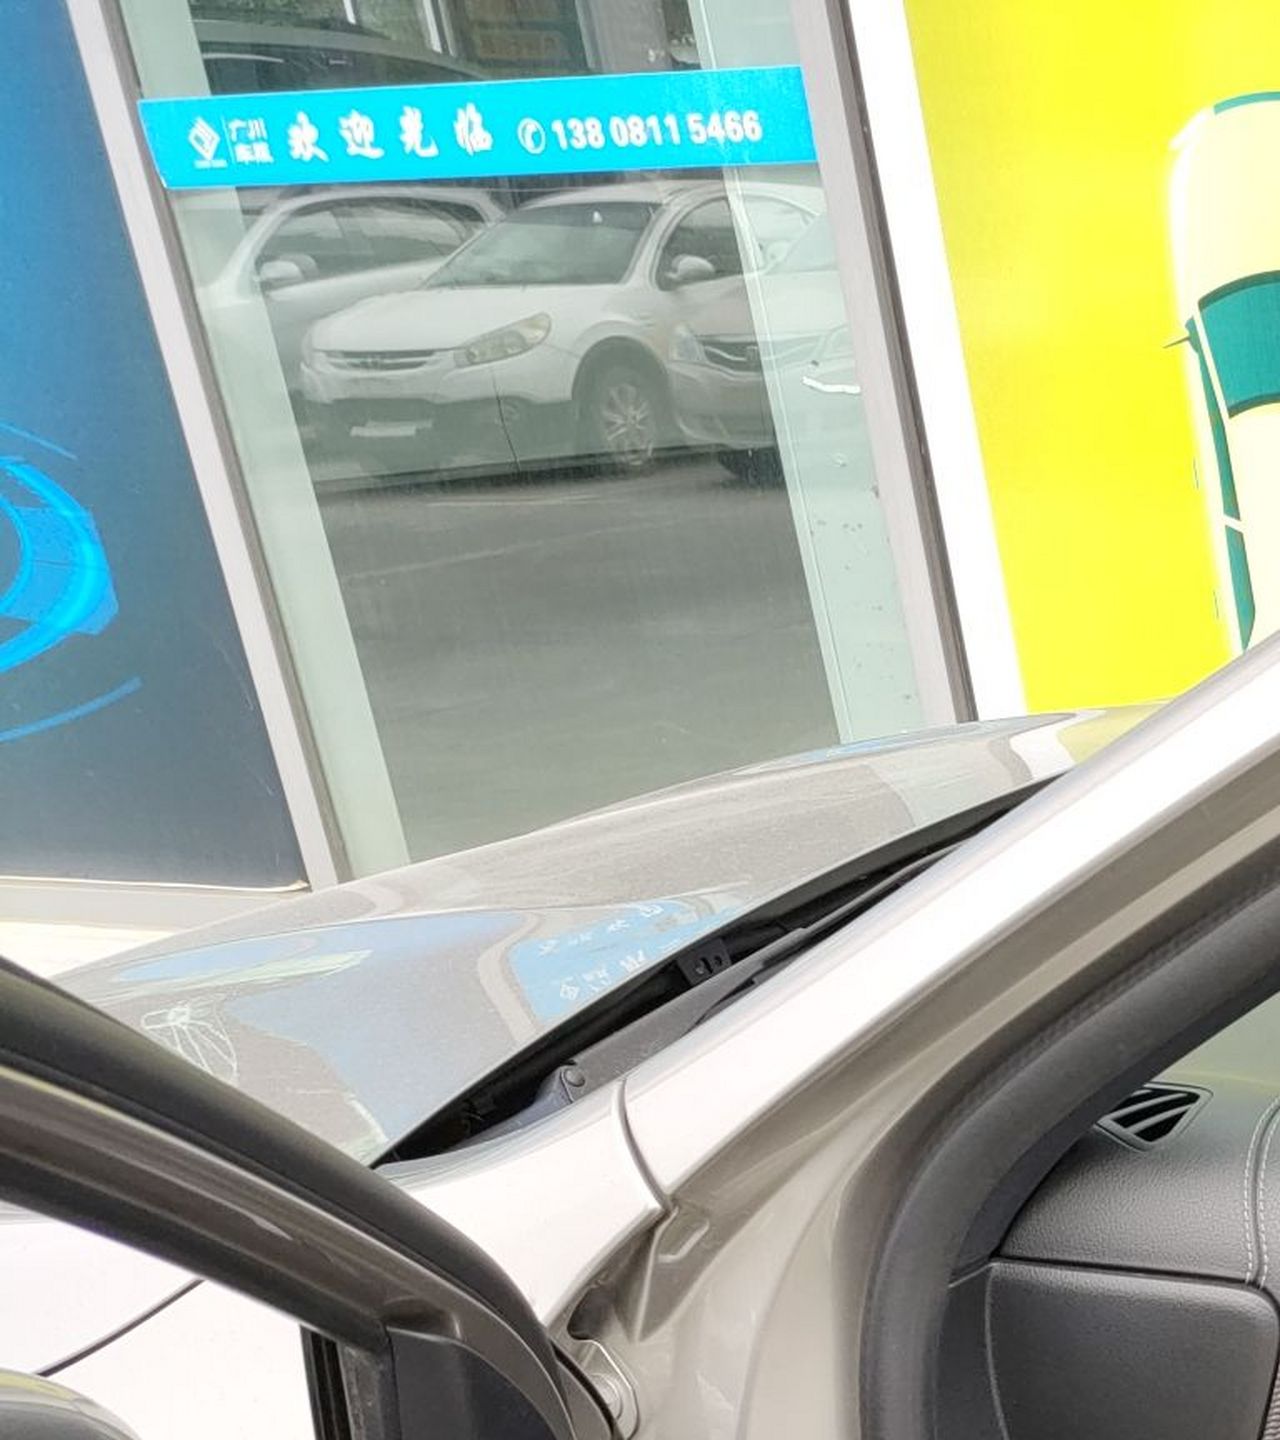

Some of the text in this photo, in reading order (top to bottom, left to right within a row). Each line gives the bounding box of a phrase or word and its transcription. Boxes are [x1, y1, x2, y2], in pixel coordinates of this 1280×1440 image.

[287, 101, 493, 162] 欢迎光临
[551, 116, 606, 151] 138
[609, 113, 681, 148] 0811
[685, 109, 763, 145] 5466
